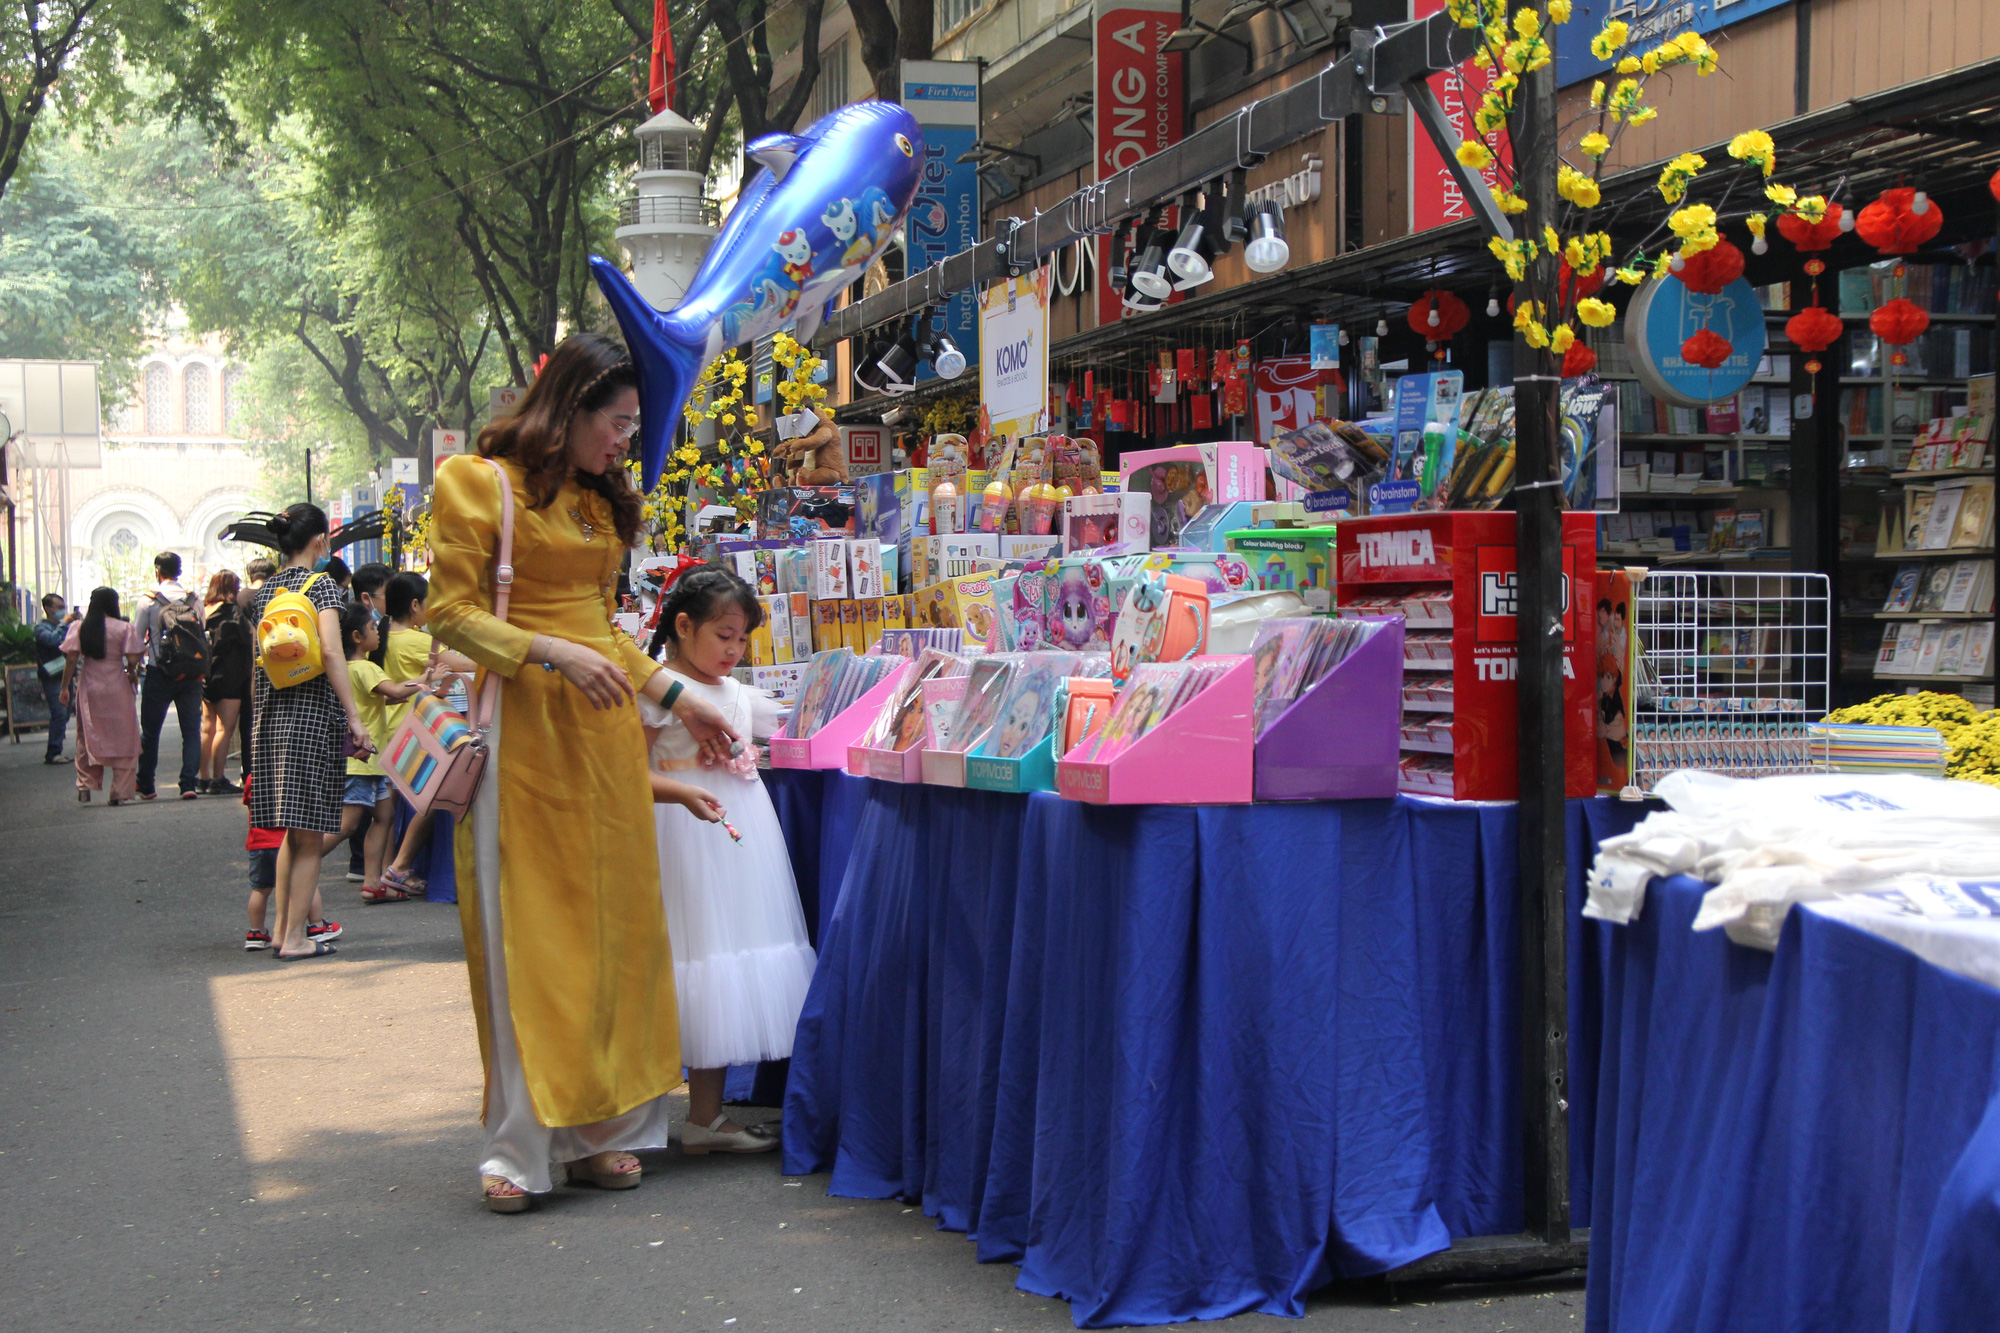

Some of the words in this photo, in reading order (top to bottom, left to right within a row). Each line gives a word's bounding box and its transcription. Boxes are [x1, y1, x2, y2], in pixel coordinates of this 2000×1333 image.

[1112, 21, 1146, 55] A
[927, 86, 950, 97] First
[951, 87, 977, 98] News
[1104, 67, 1147, 174] ÔNG
[1157, 102, 1169, 150] STOCK
[996, 340, 1028, 377] KOMO
[1288, 448, 1319, 468] Space
[1317, 439, 1345, 457] Torch
[1226, 454, 1239, 500] Series
[1313, 494, 1347, 509] brainstorm
[1380, 486, 1418, 501] brainstorm
[1259, 541, 1284, 550] building
[1284, 542, 1304, 550] blocks
[1356, 529, 1436, 568] TOMICA
[971, 760, 1014, 781] TOPModel
[1064, 768, 1103, 790] TOPModel
